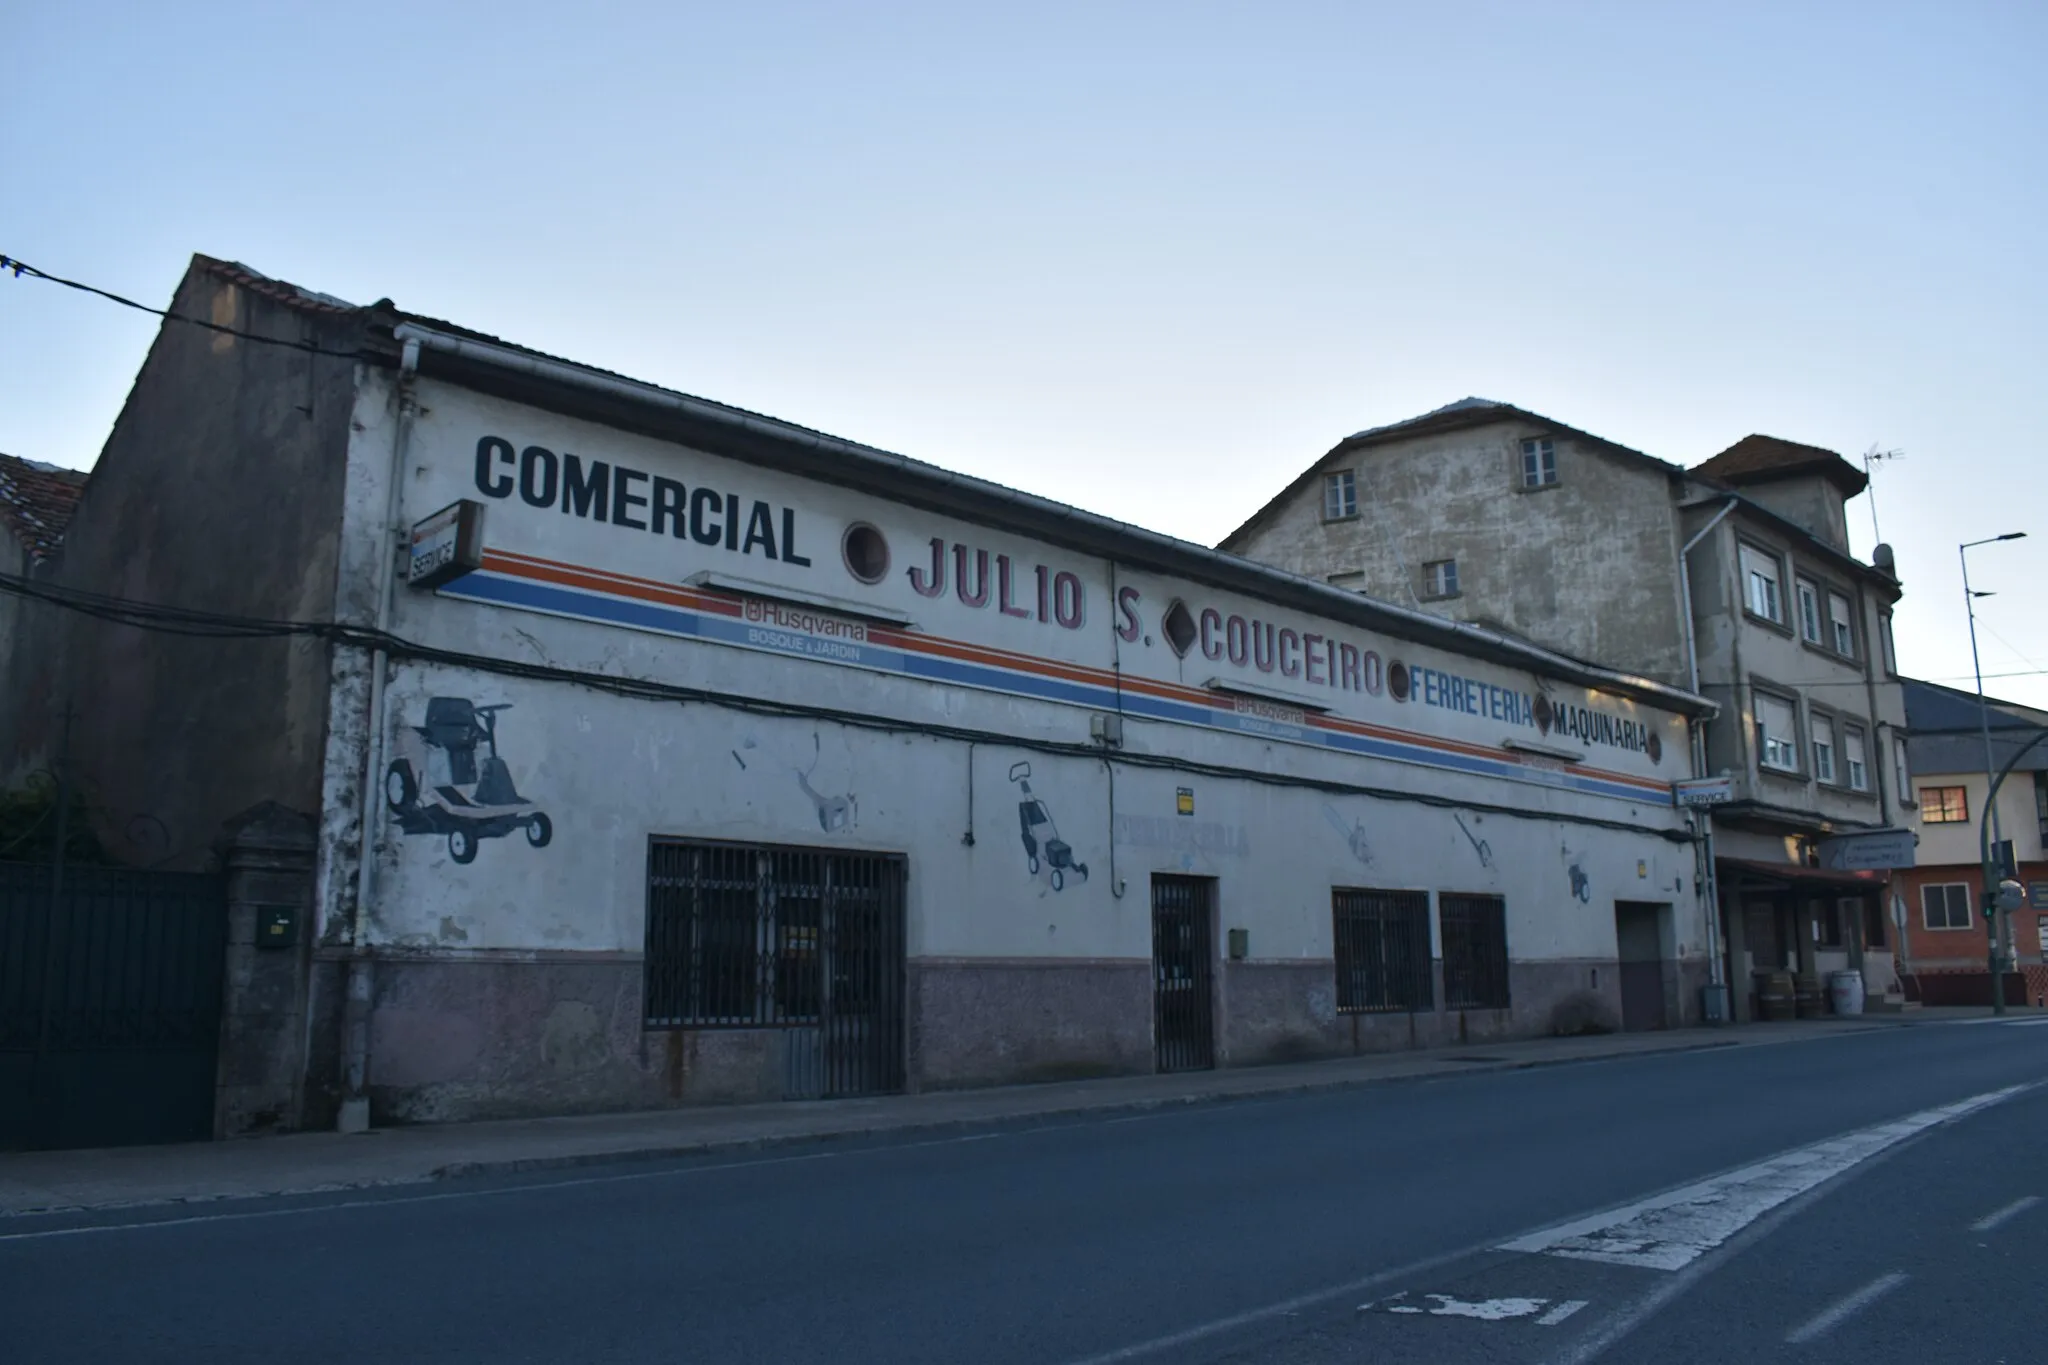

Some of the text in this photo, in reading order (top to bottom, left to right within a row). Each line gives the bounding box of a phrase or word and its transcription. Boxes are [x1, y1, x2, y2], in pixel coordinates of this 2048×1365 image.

[475, 435, 811, 568] COMERCIAL
[749, 629, 804, 652] BOSQUE
[814, 642, 861, 661] JARDIN
[763, 602, 865, 641] Husqvarna
[906, 537, 1383, 695] JULIO S. COUCEIRO
[1409, 664, 1534, 728] FERRETERIA
[1553, 700, 1648, 754] MAQUINARIA
